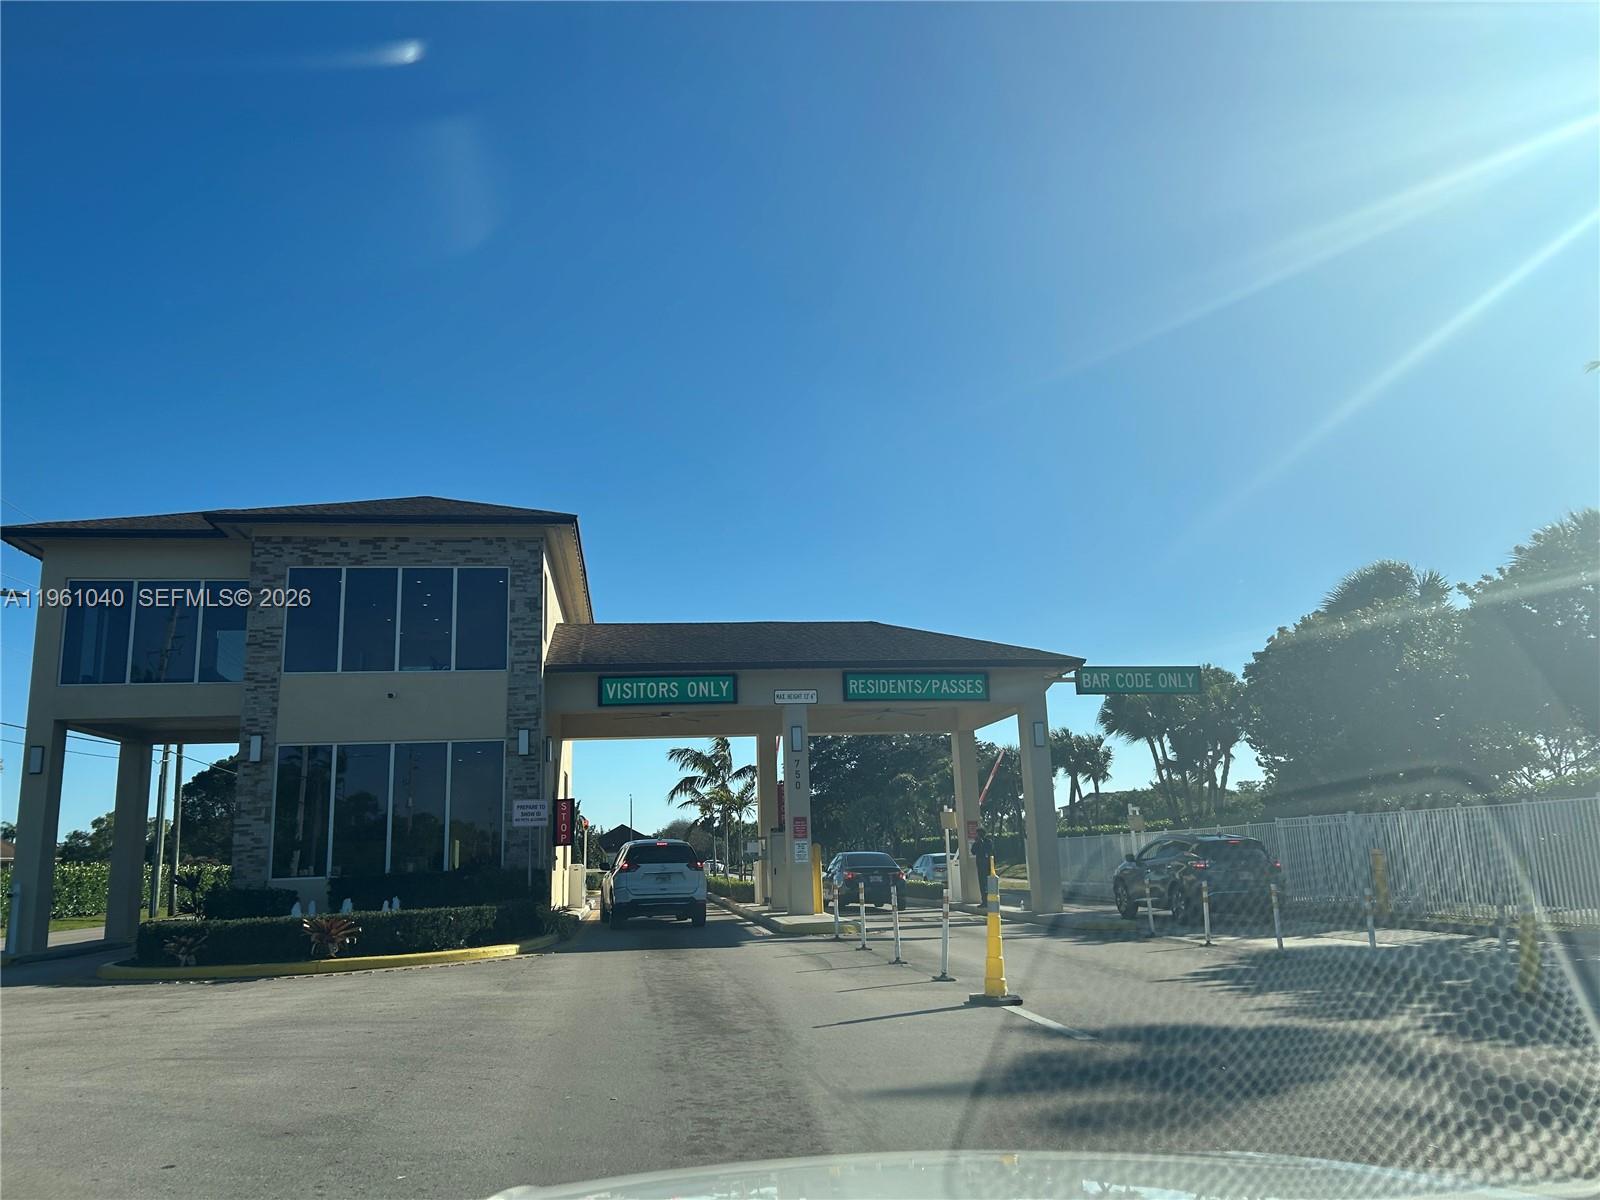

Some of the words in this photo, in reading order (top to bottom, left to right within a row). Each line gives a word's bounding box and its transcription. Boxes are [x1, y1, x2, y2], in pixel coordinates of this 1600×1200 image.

[849, 679, 984, 694] RESIDENTS/PASSES
[1081, 672, 1110, 689] BAR
[1115, 672, 1154, 689] CODE
[1158, 672, 1196, 689] ONLY
[606, 682, 679, 700] VISITORS
[687, 681, 730, 698] ONLY
[560, 802, 568, 843] STOP
